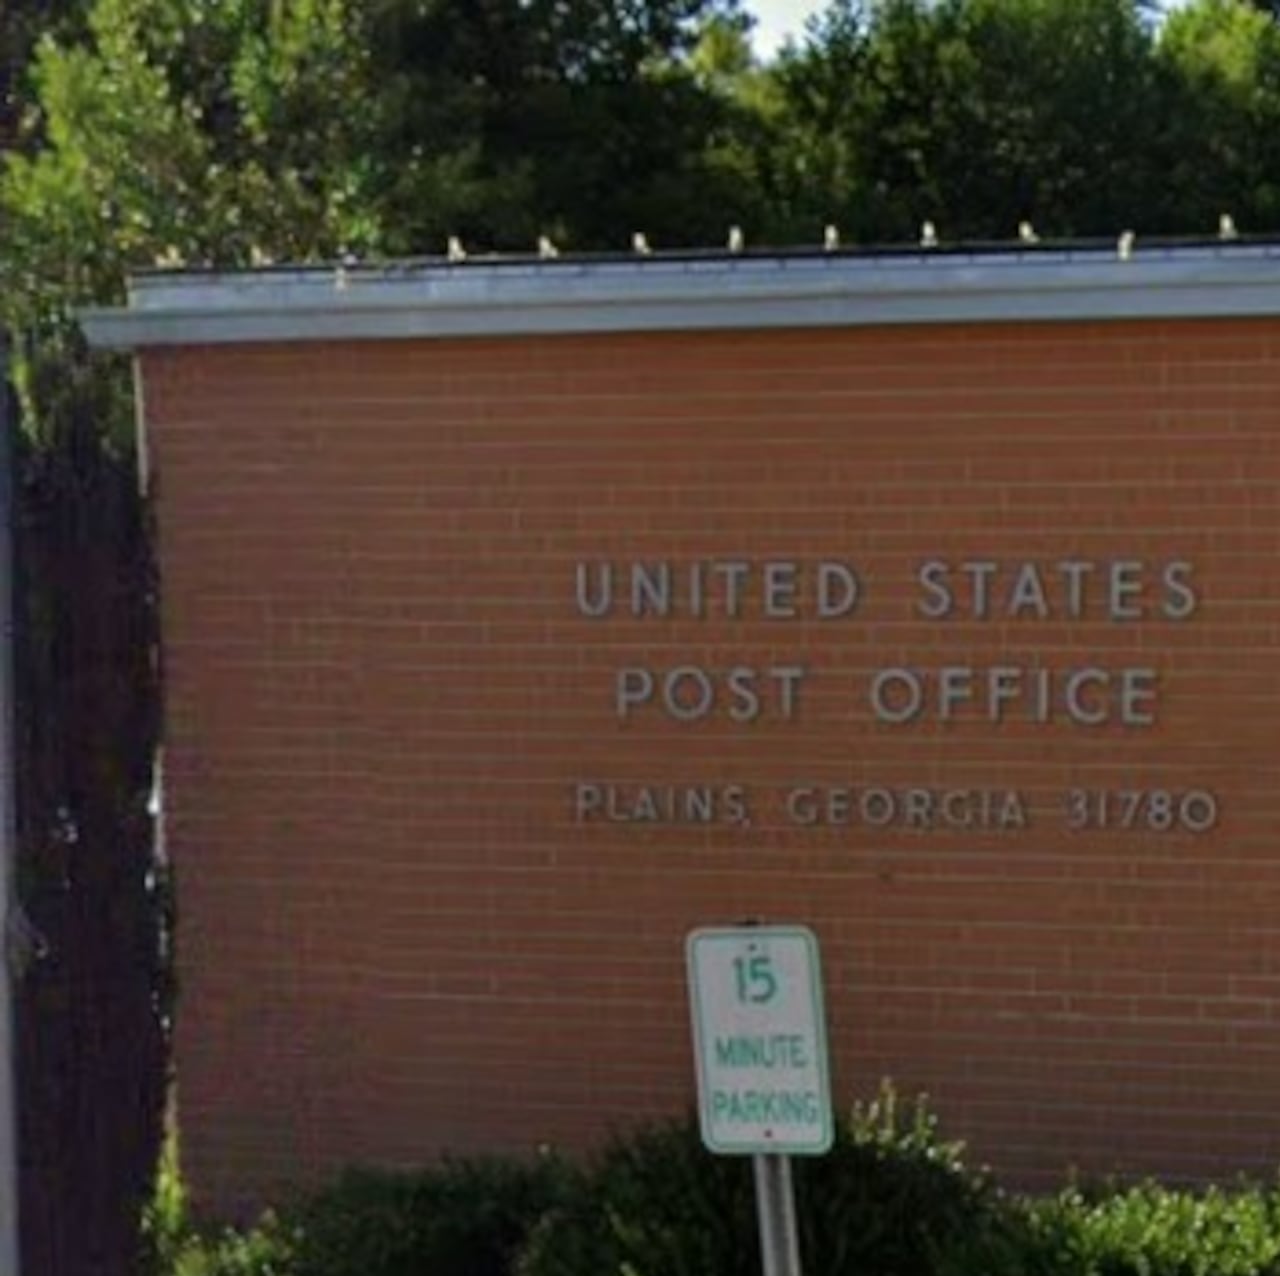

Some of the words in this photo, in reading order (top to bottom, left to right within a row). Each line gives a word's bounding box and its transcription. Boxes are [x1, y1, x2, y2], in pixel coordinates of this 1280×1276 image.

[574, 562, 858, 618] UNITED
[917, 562, 1198, 618] STATES
[615, 666, 806, 720] POST
[869, 667, 1158, 724] OFFICE
[575, 784, 751, 828] PLAINS,
[790, 786, 1026, 828] GEORGIA
[1067, 788, 1218, 830] 31780
[732, 956, 777, 1003] 15
[716, 1035, 806, 1068] MINUTE
[712, 1090, 818, 1124] PARKING
